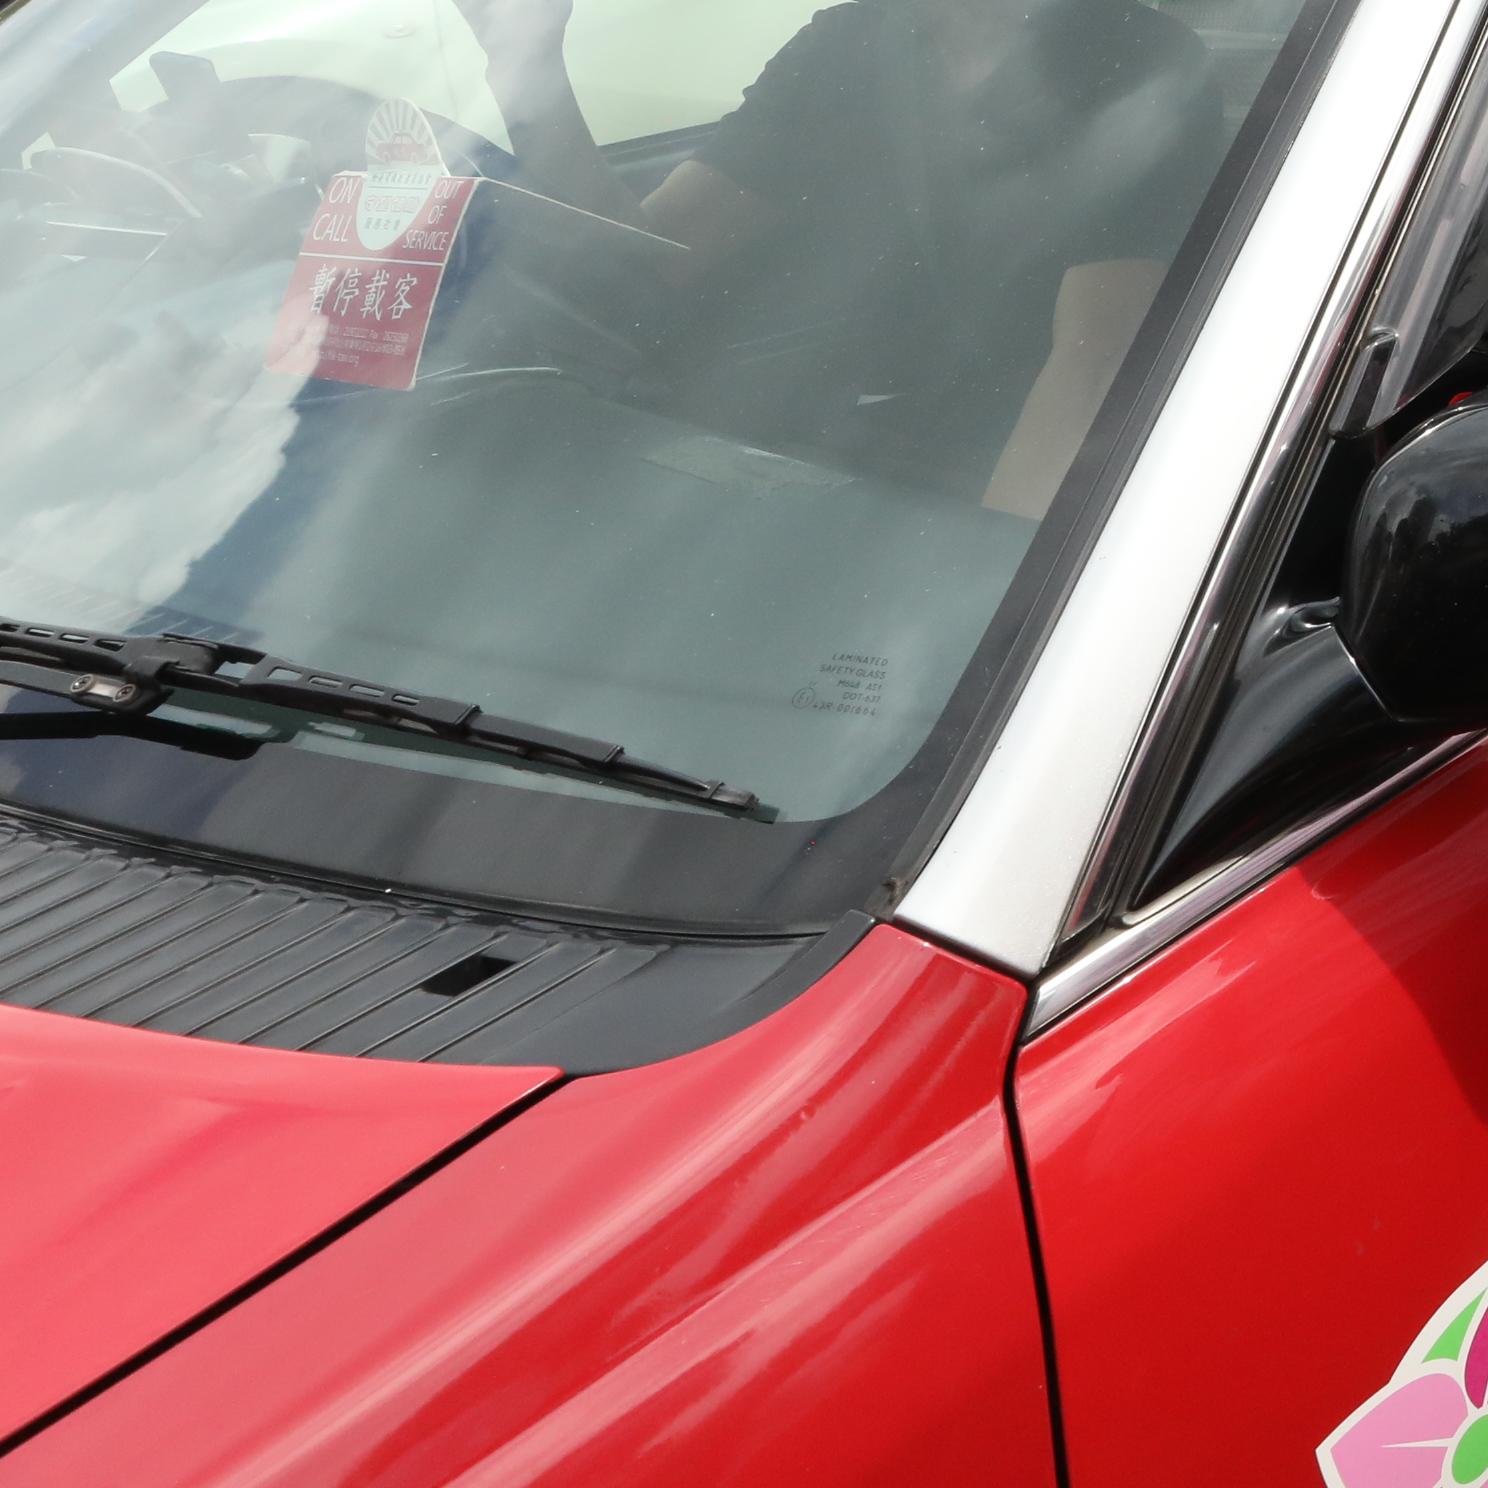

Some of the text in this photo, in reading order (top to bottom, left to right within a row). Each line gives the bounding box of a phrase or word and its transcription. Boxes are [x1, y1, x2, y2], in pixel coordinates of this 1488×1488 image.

[328, 177, 357, 204] ON
[433, 178, 461, 201] OUT
[426, 204, 448, 225] OF
[312, 213, 353, 243] CALL
[401, 228, 450, 252] SERVICE
[308, 263, 418, 321] 暫停載客
[819, 663, 887, 680] SAFETY GLASS
[832, 653, 889, 667] LAMINATED
